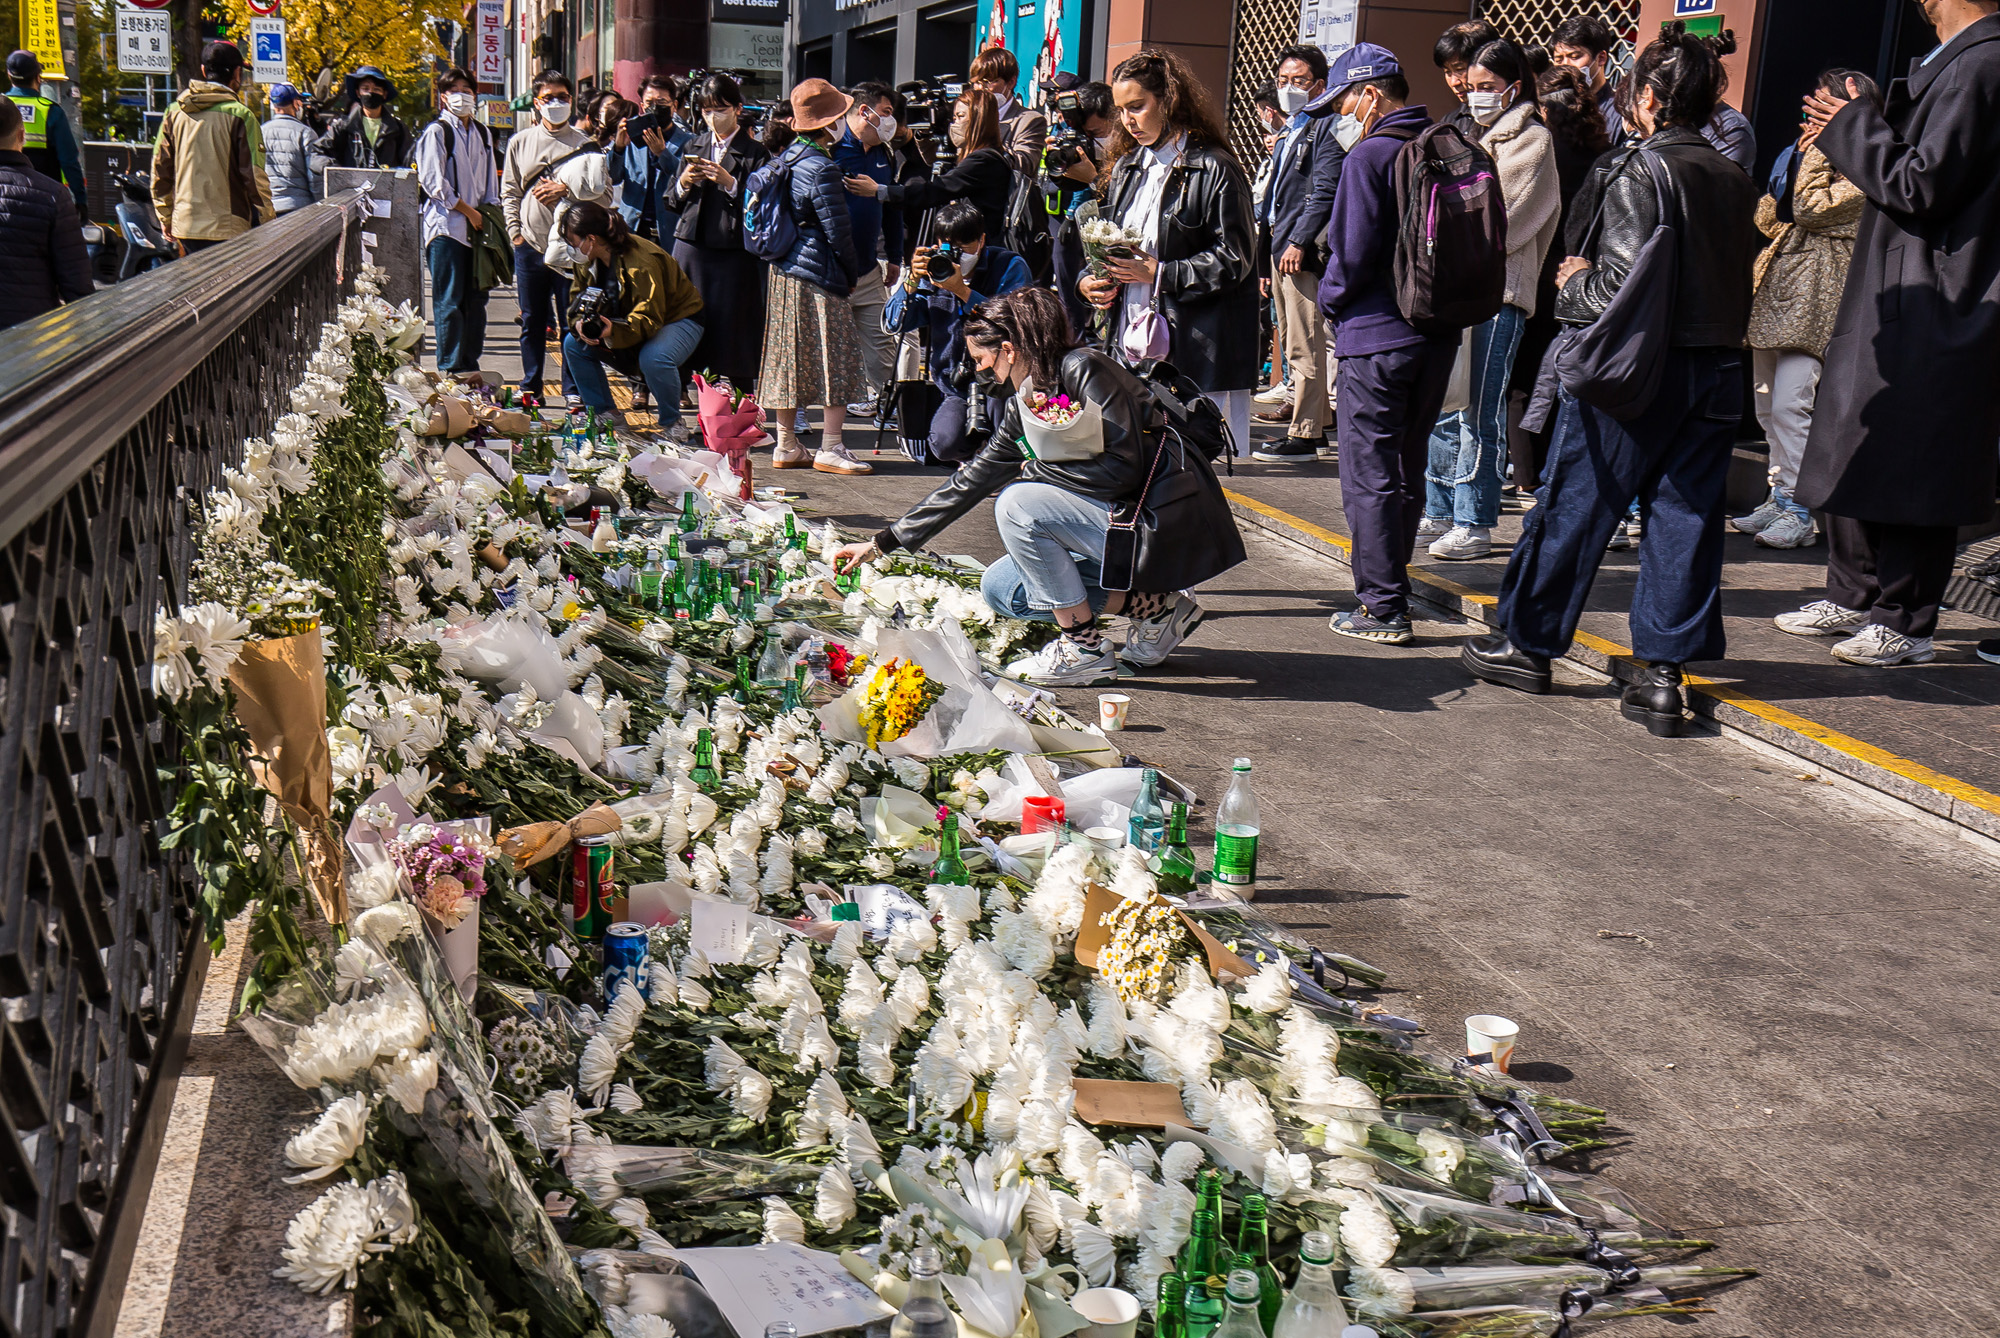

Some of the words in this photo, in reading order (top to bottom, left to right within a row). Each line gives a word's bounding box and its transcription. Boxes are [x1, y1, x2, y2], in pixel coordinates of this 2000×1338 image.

[479, 3, 504, 12] 이태원역
[121, 16, 168, 33] 보행전용거리
[128, 36, 140, 51] 매
[150, 37, 160, 52] 일
[482, 15, 501, 72] 부동산
